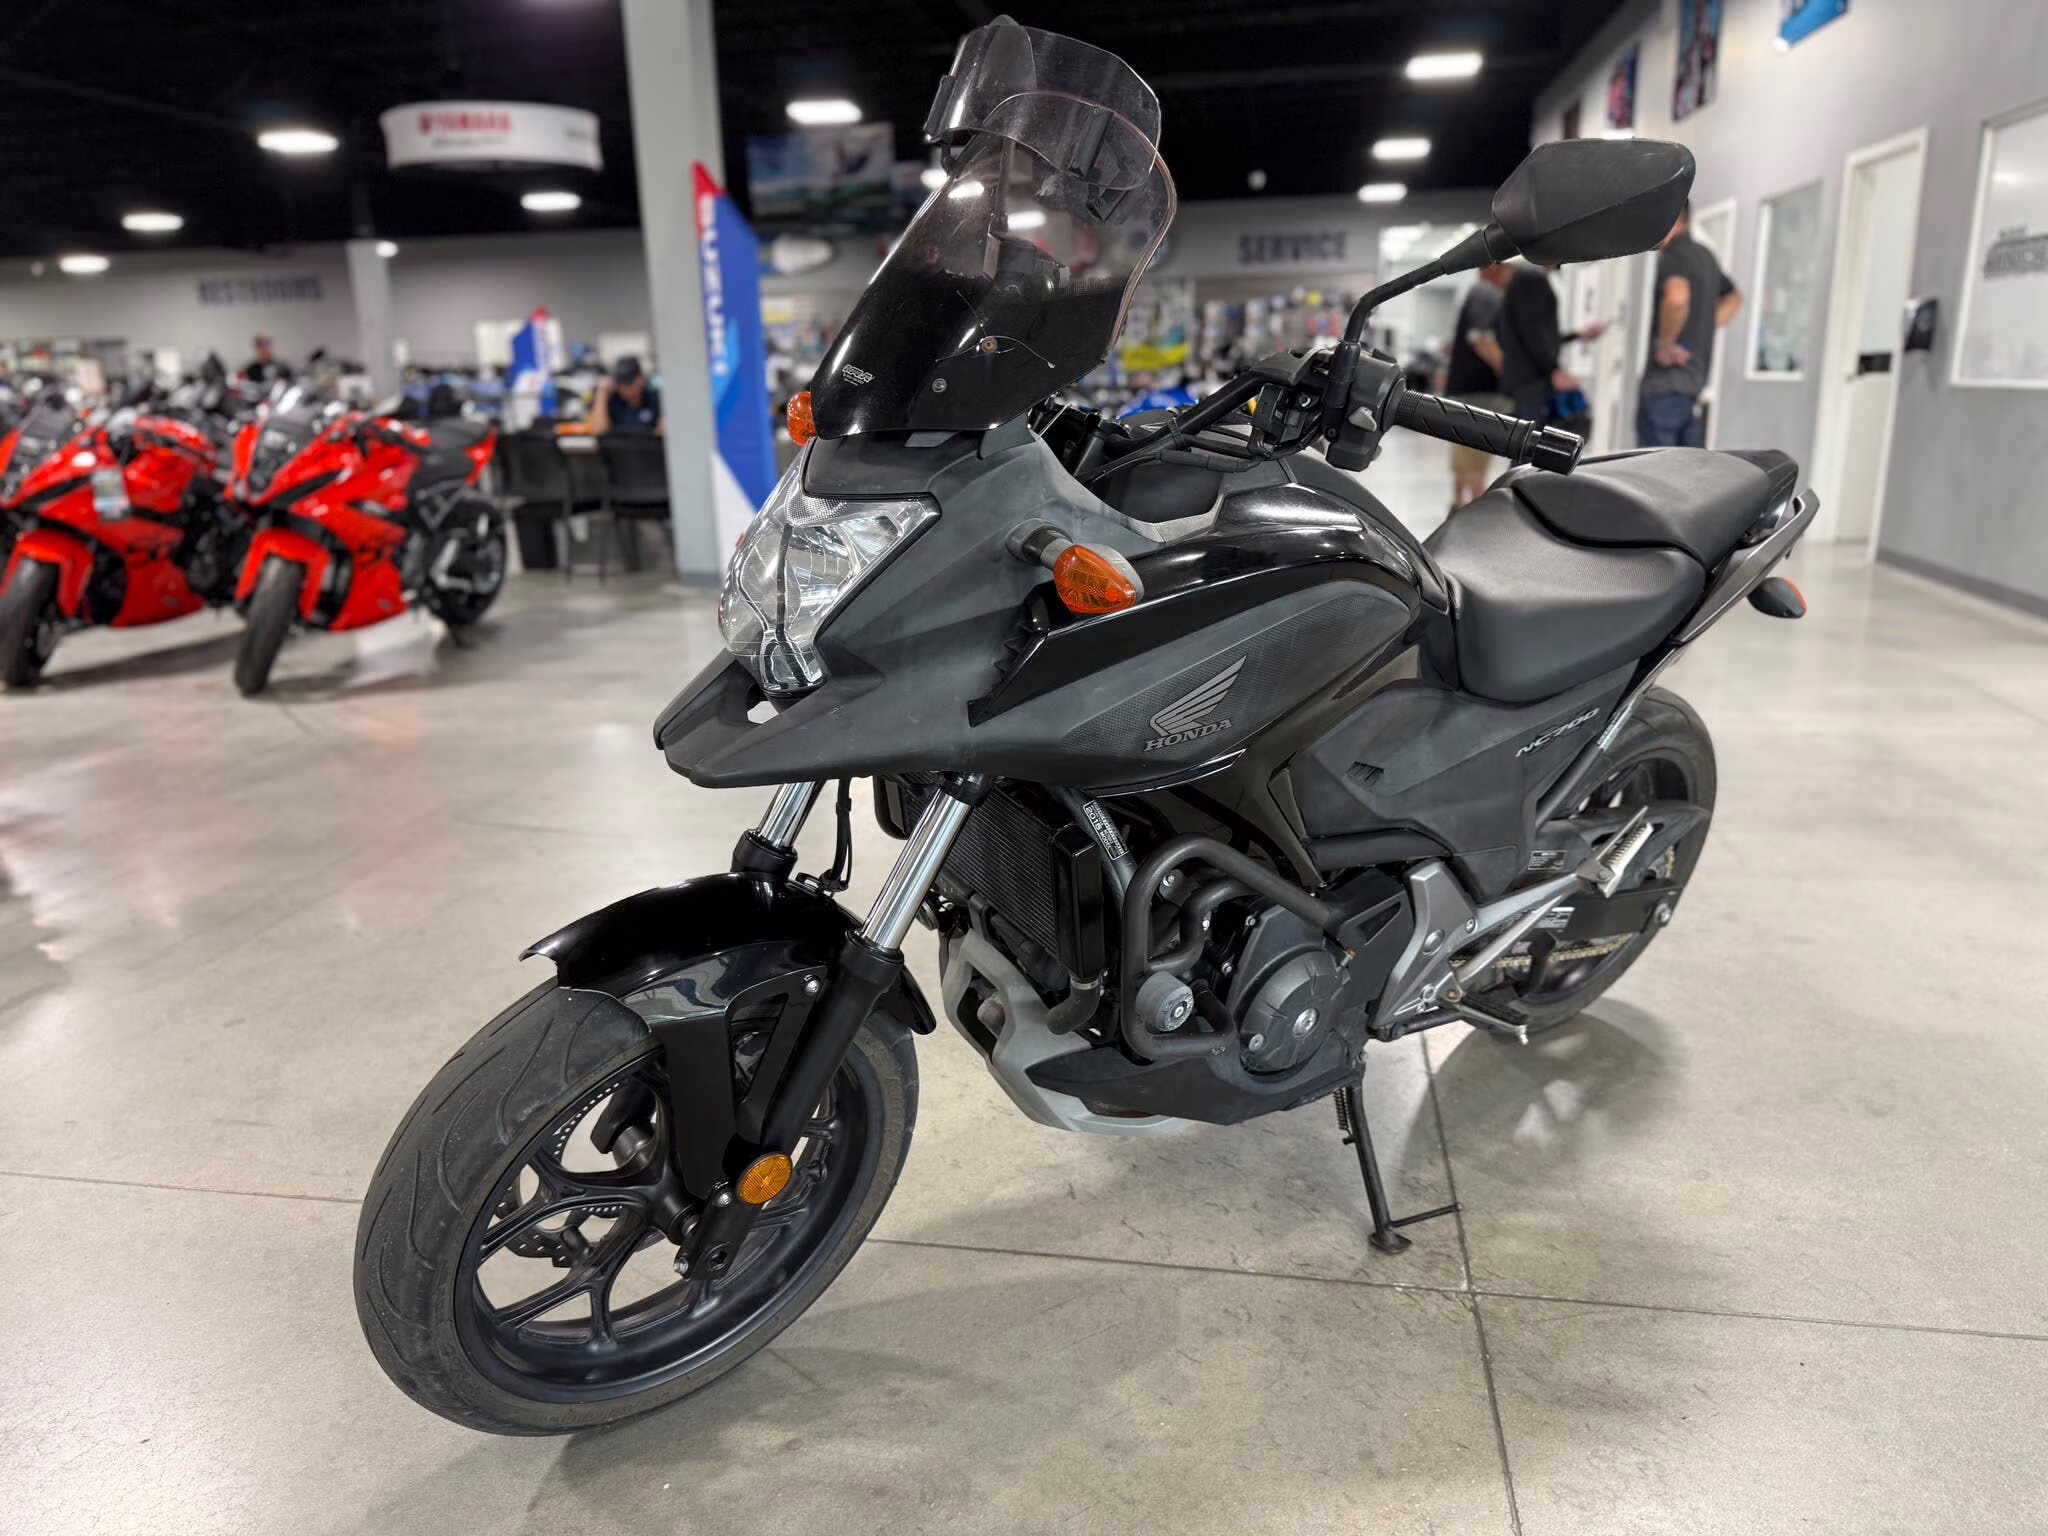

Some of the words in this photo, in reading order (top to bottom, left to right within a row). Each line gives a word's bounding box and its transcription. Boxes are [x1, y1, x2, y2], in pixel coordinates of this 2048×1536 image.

[1239, 233, 1345, 263] SERVICE
[1143, 719, 1233, 752] HONDA
[1515, 708, 1600, 757] NC700
